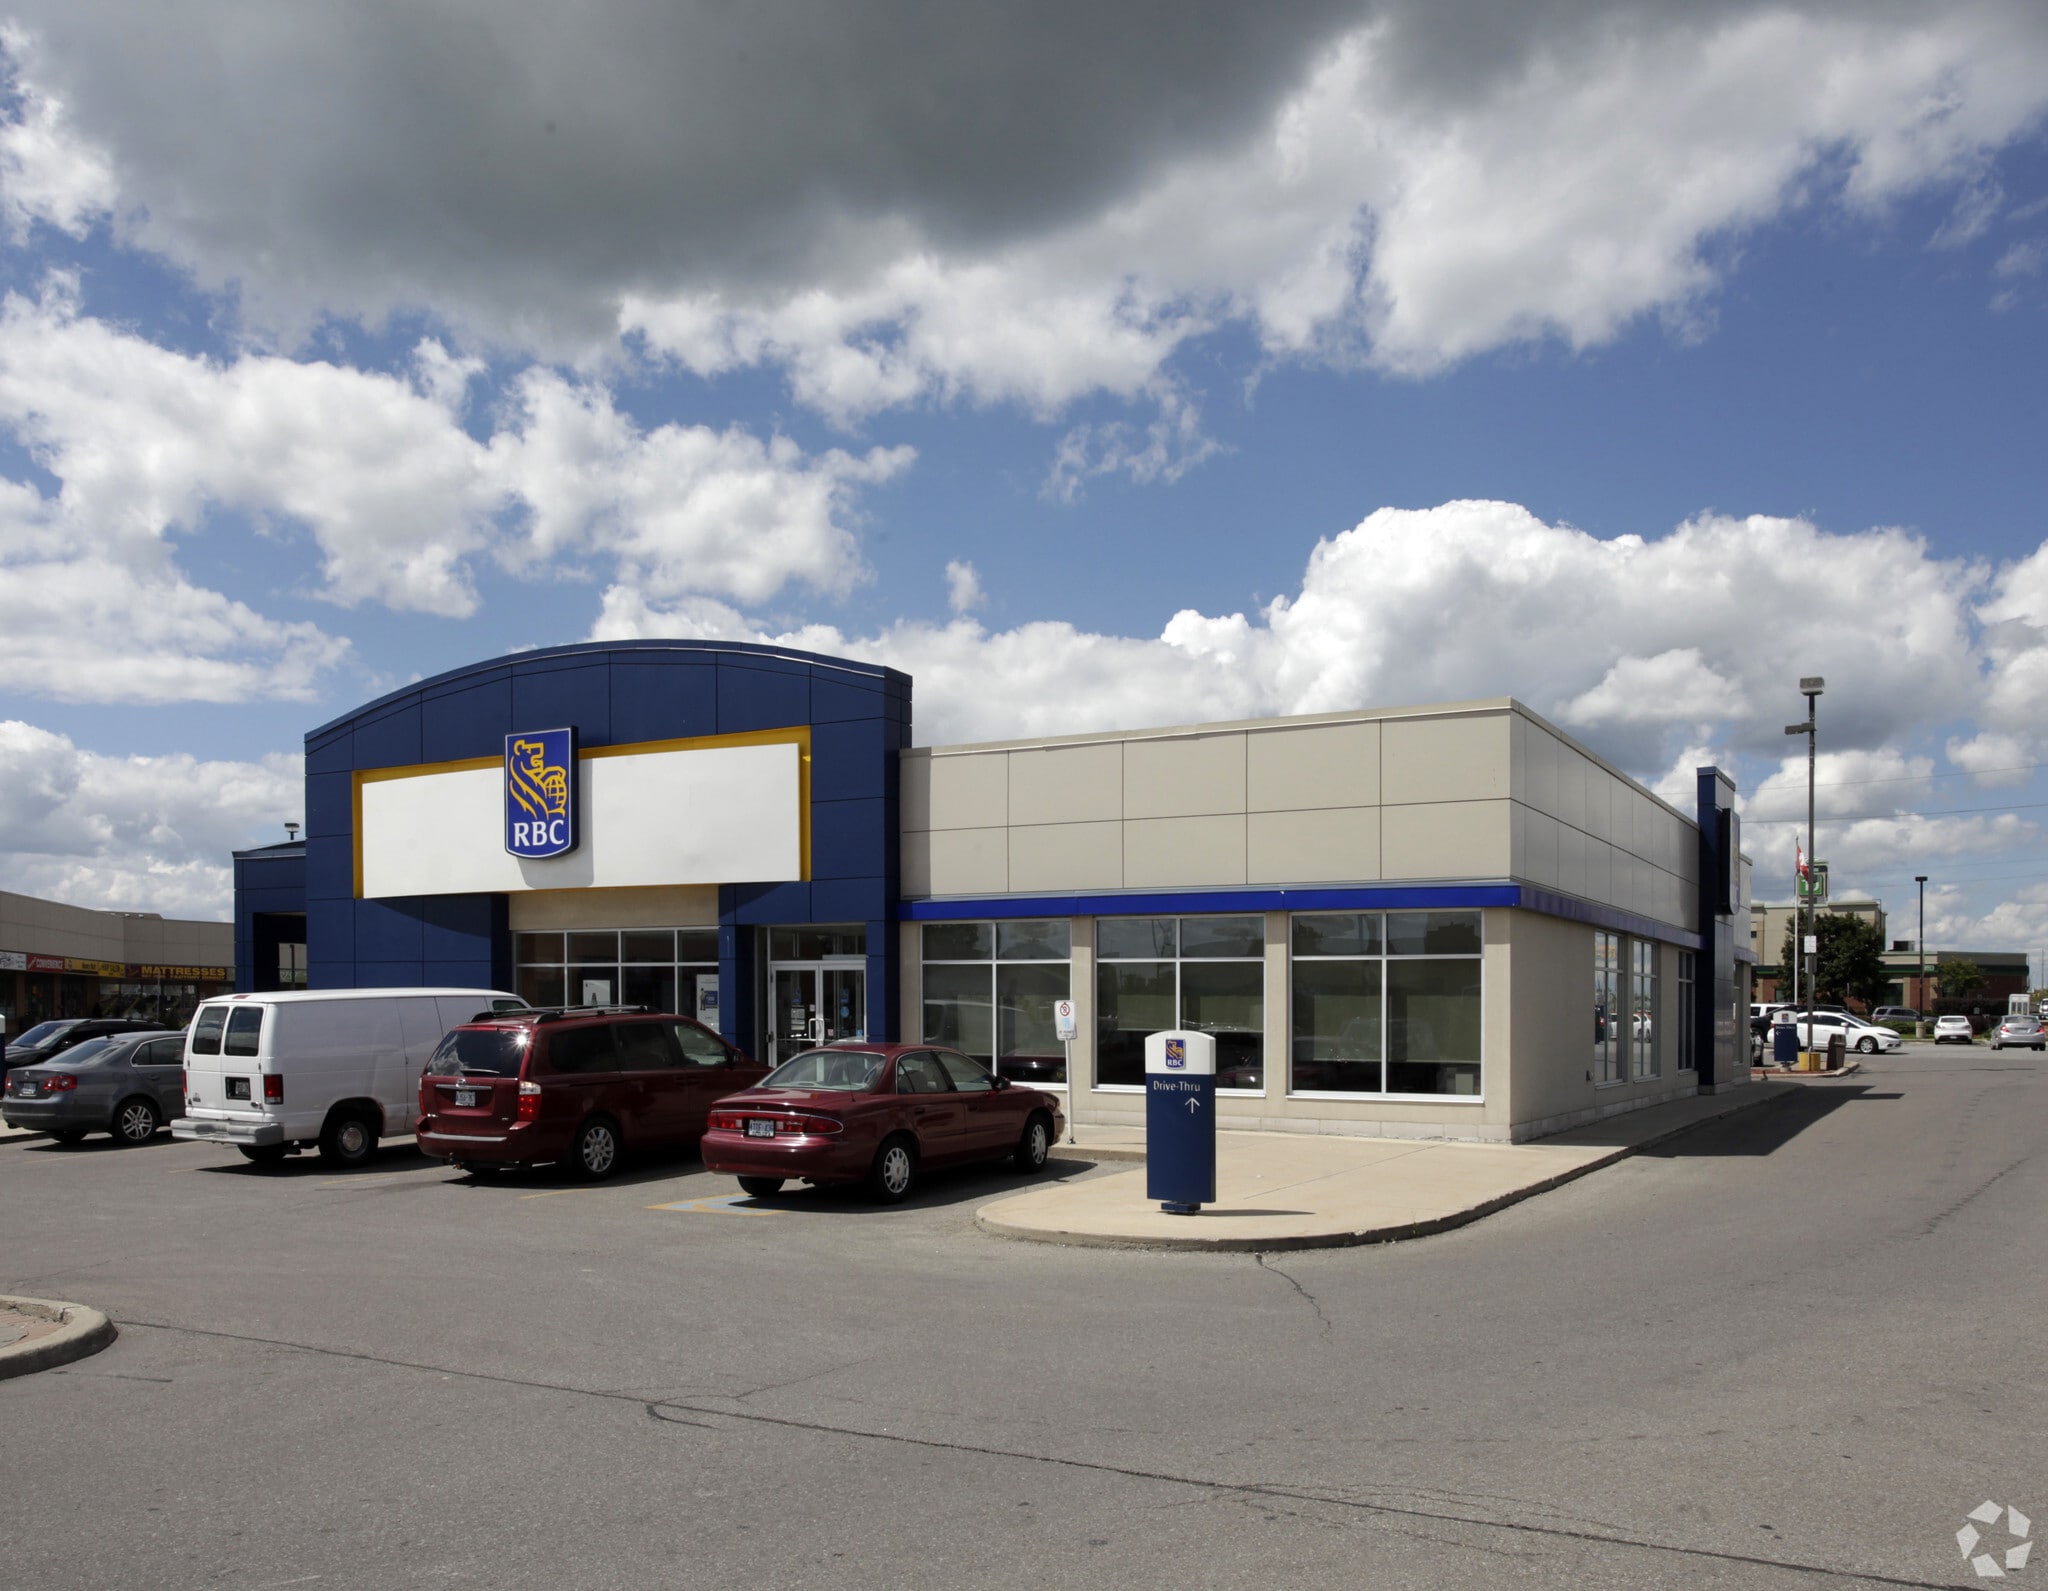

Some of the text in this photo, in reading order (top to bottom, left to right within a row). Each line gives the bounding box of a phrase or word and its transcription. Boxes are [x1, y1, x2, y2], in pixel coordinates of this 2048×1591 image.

[513, 819, 565, 848] RBC
[141, 966, 226, 976] MATTRESSES
[1153, 1080, 1201, 1092] Drive-Thru
